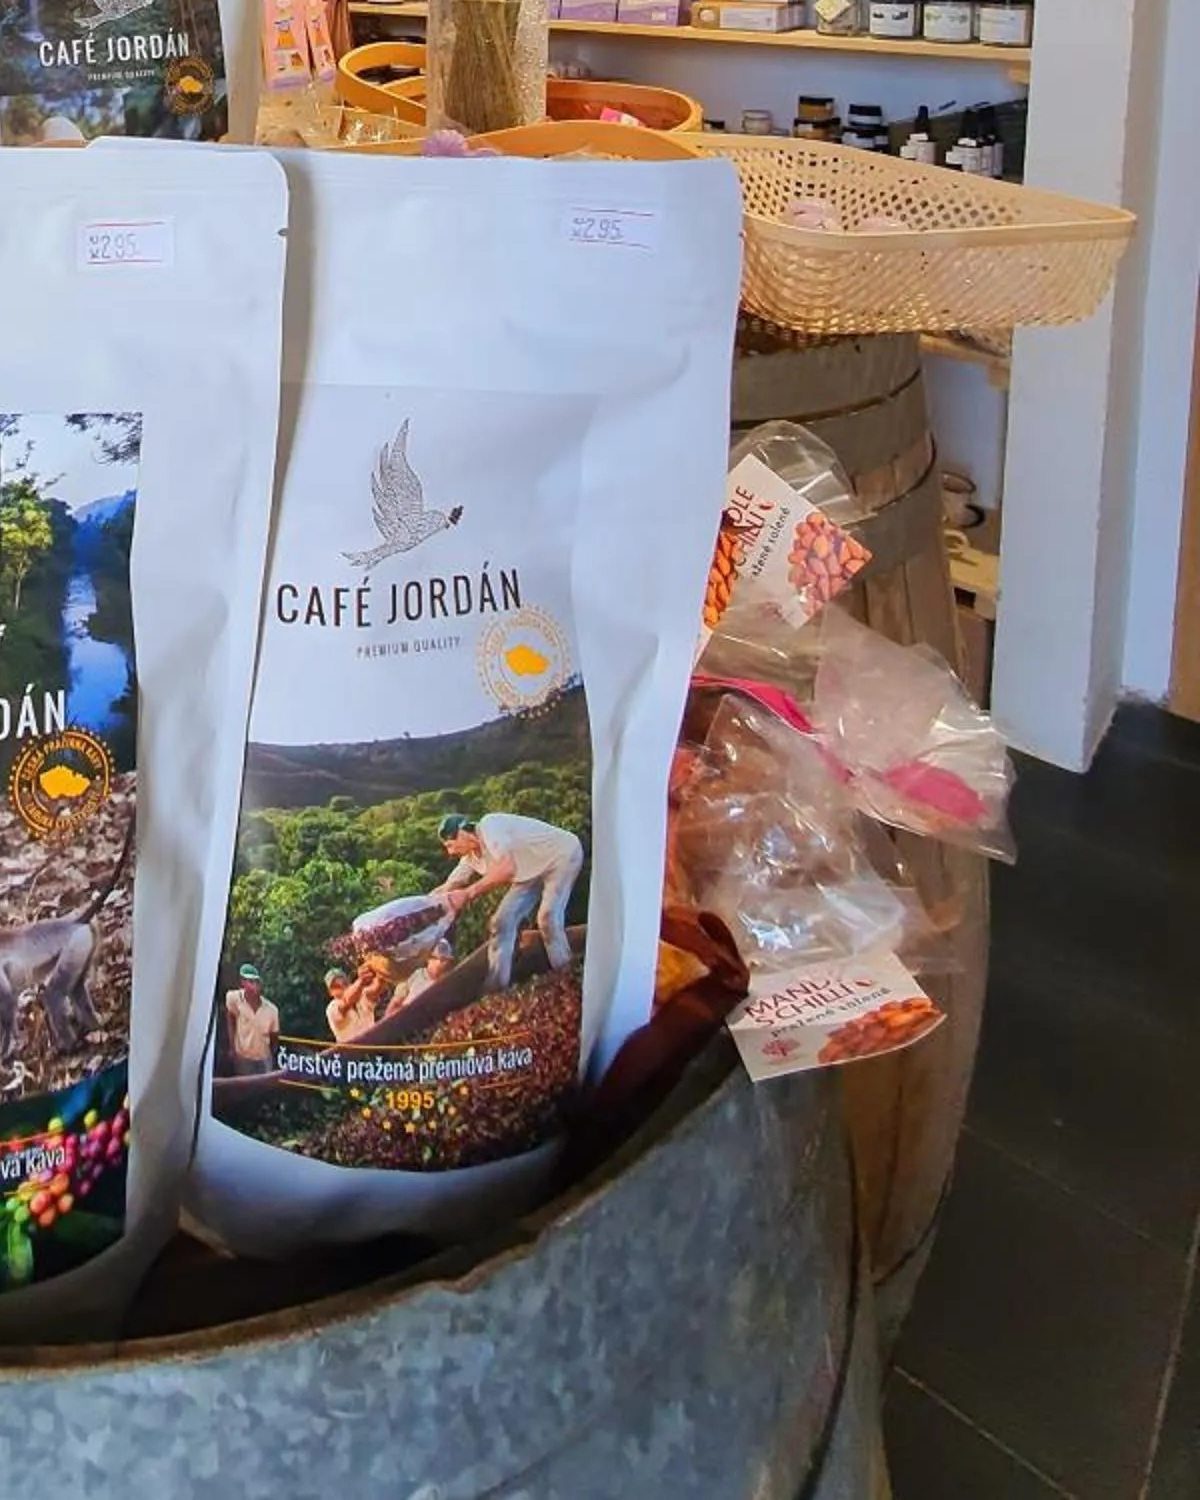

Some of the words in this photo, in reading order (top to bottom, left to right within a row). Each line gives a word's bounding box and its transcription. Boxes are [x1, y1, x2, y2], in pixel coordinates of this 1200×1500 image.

[39, 32, 96, 67] CAFÉ
[107, 27, 190, 63] JORDÁN
[276, 575, 371, 628] CAFÉ
[387, 561, 521, 625] JORDÁN
[356, 641, 408, 659] PREMIUM
[413, 635, 461, 654] QUALITY
[277, 1046, 341, 1078] čerstvě
[347, 1055, 414, 1083] pražená
[386, 1090, 434, 1109] 1995
[26, 1145, 67, 1174] káva
